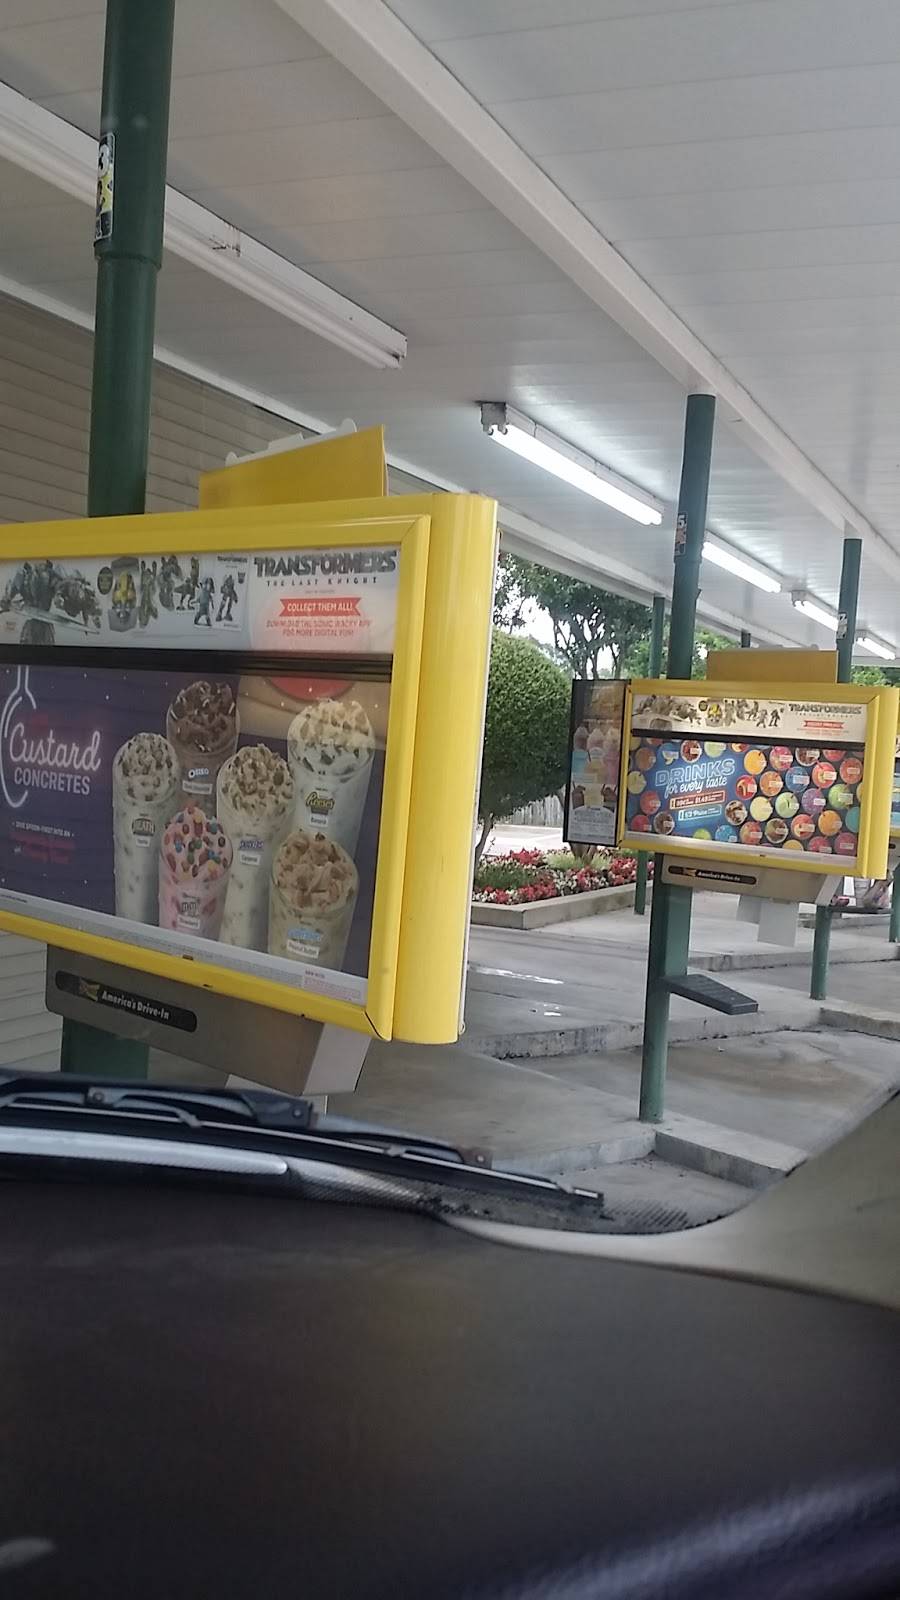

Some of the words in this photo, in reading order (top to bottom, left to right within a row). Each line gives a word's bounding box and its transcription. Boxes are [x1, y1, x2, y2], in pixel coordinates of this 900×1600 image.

[253, 550, 397, 578] TRANSFORMERS
[267, 579, 285, 587] THE
[291, 579, 319, 587] LAST
[327, 576, 377, 586] KNIGHT
[287, 603, 317, 613] COLLECT
[318, 602, 337, 612] THEM
[338, 602, 354, 612] ALL!
[9, 722, 101, 771] Custard
[14, 767, 90, 795] CONCRETES
[655, 758, 735, 787] DRINKS
[664, 779, 679, 799] for
[680, 780, 704, 794] every
[706, 775, 727, 788] taste
[101, 990, 137, 1010] America's
[137, 1001, 169, 1020] Drive-In
